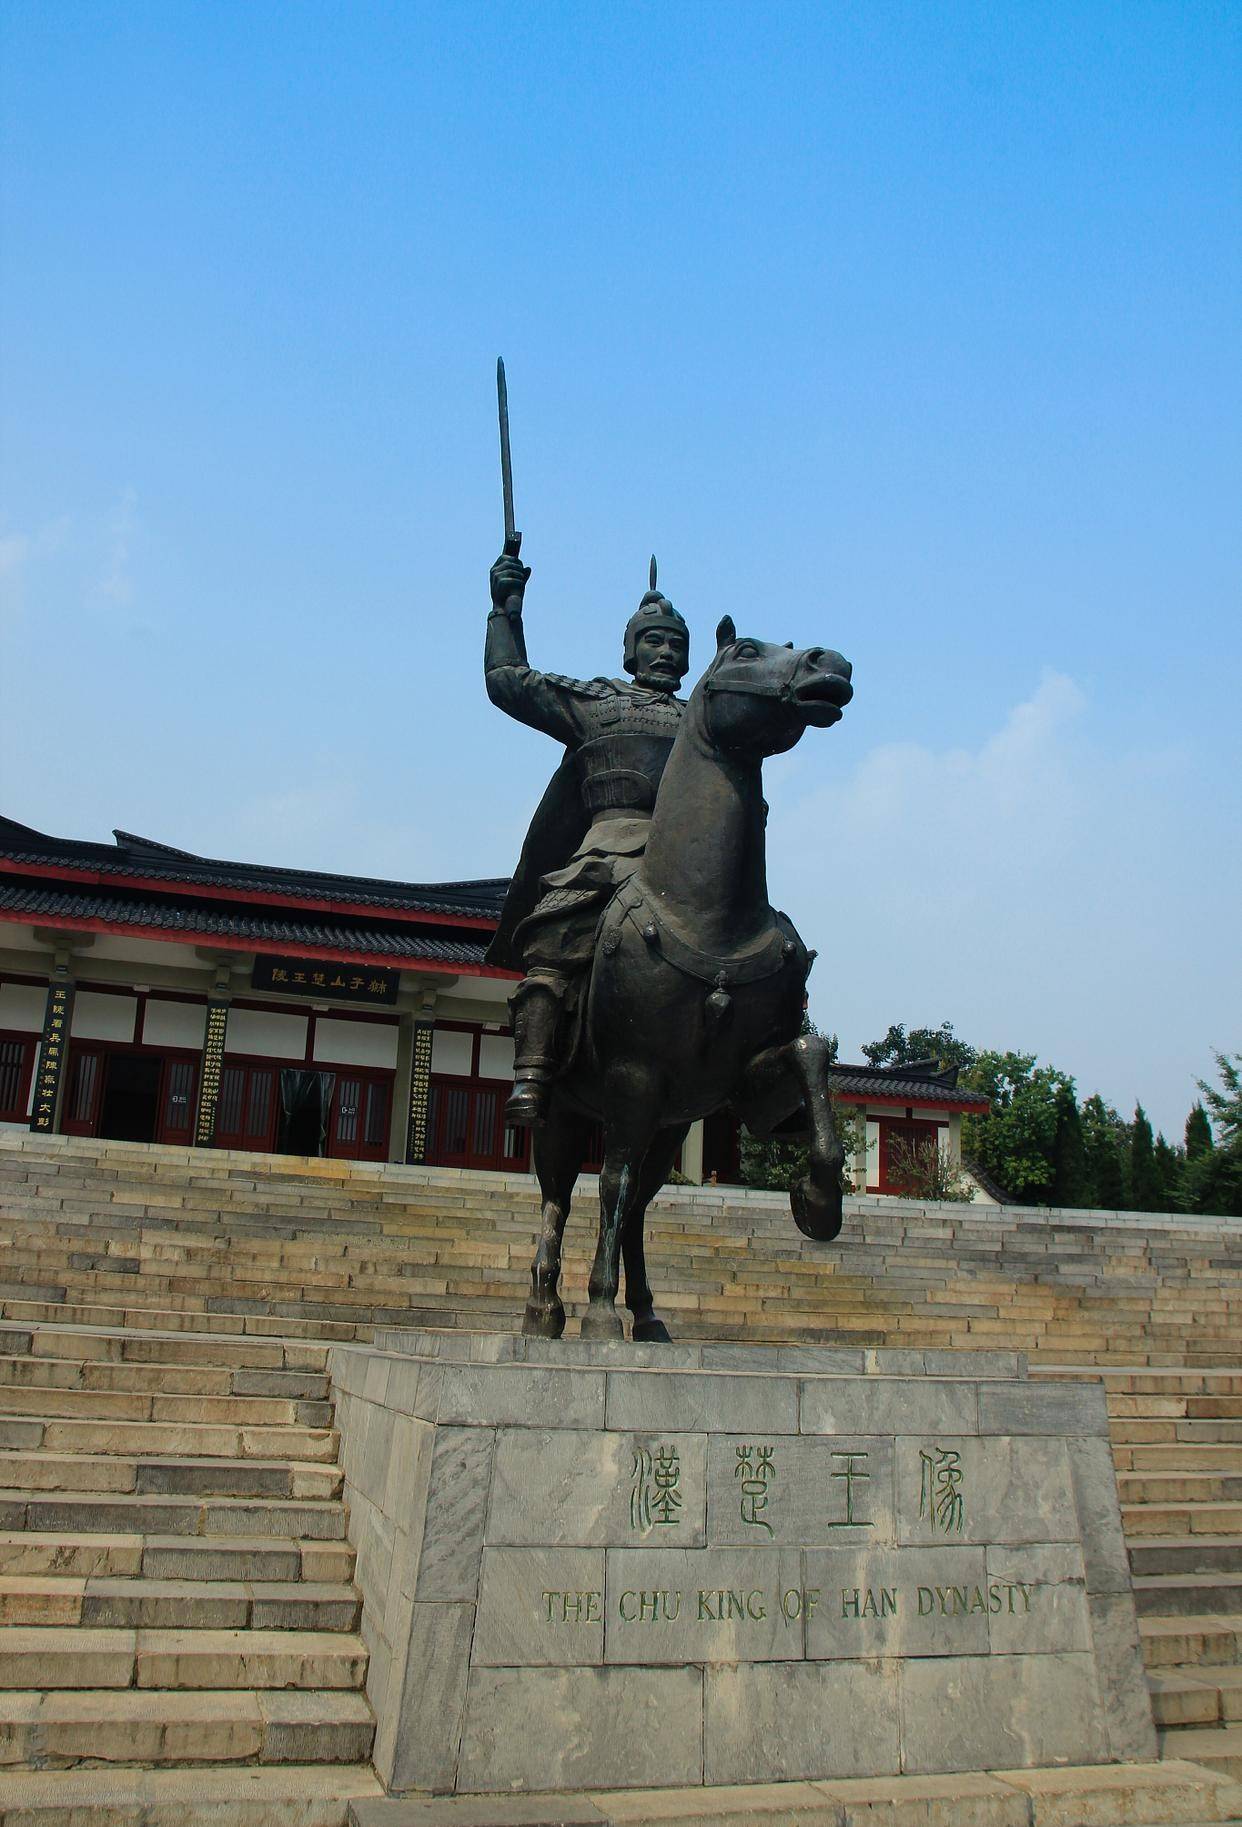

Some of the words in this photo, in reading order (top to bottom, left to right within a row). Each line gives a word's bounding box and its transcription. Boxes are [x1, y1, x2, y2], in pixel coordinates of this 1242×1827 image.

[542, 1591, 602, 1622] THE
[619, 1590, 682, 1622] CHU
[698, 1588, 768, 1621] KING
[783, 1588, 820, 1620] OF
[842, 1587, 899, 1618] HAN
[917, 1584, 1035, 1618] DYNASTY
